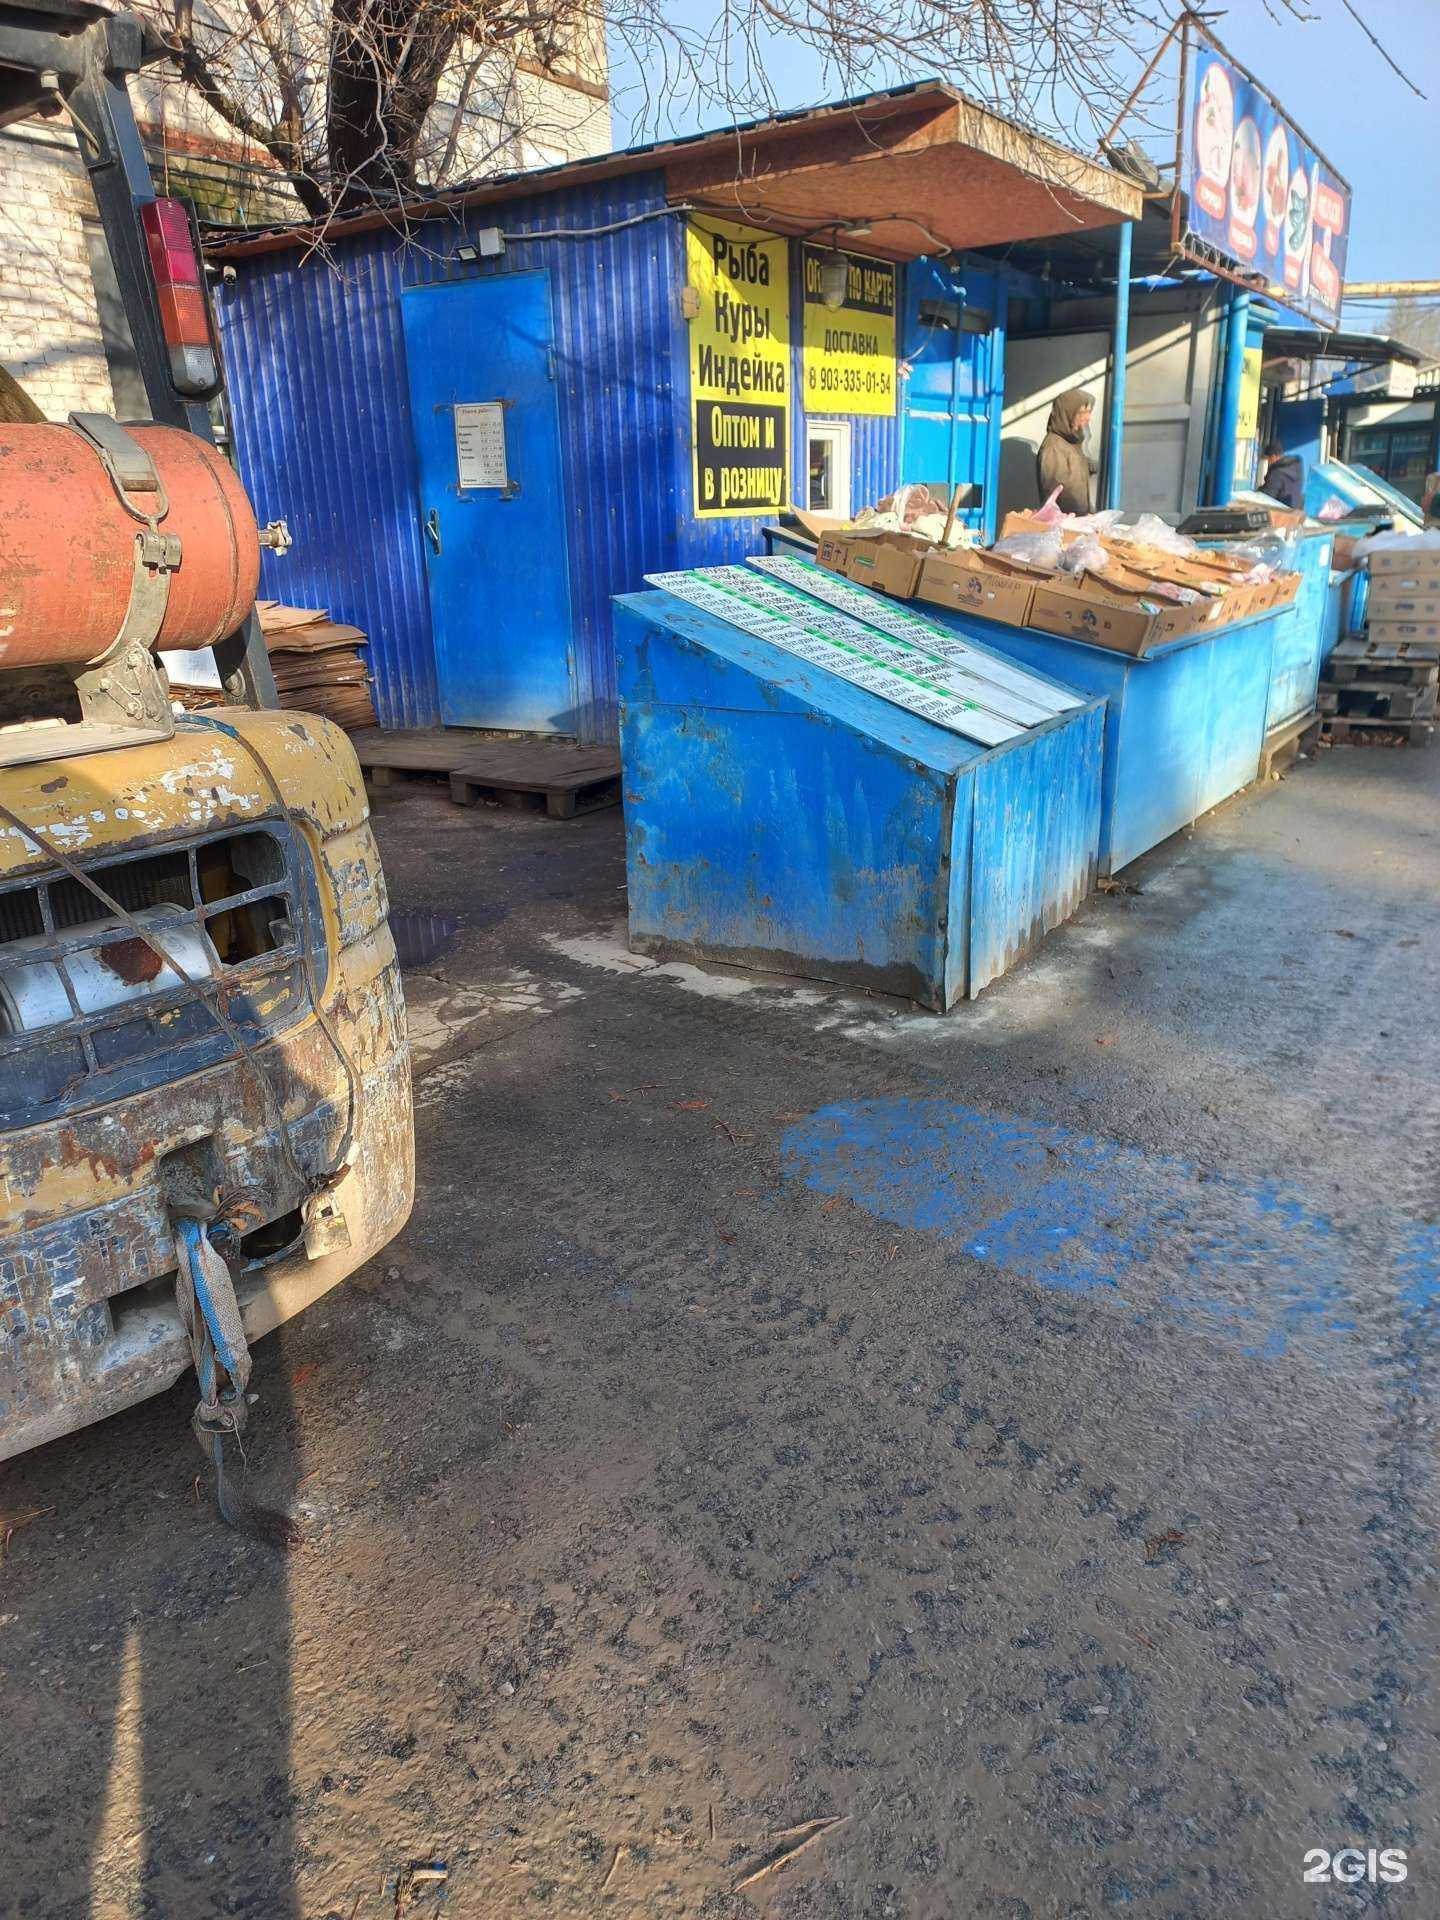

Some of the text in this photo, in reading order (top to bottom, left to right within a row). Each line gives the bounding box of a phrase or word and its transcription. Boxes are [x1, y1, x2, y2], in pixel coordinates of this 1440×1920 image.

[713, 233, 770, 287] Рыба
[864, 269, 893, 307] КАРТЕ
[714, 290, 770, 343] Куры
[824, 329, 879, 357] ДОСТАВКА
[699, 344, 785, 396] Индейка
[809, 367, 891, 394] 8 903-335-01-54
[711, 405, 775, 449] Оптом и
[704, 465, 783, 506] в розницу
